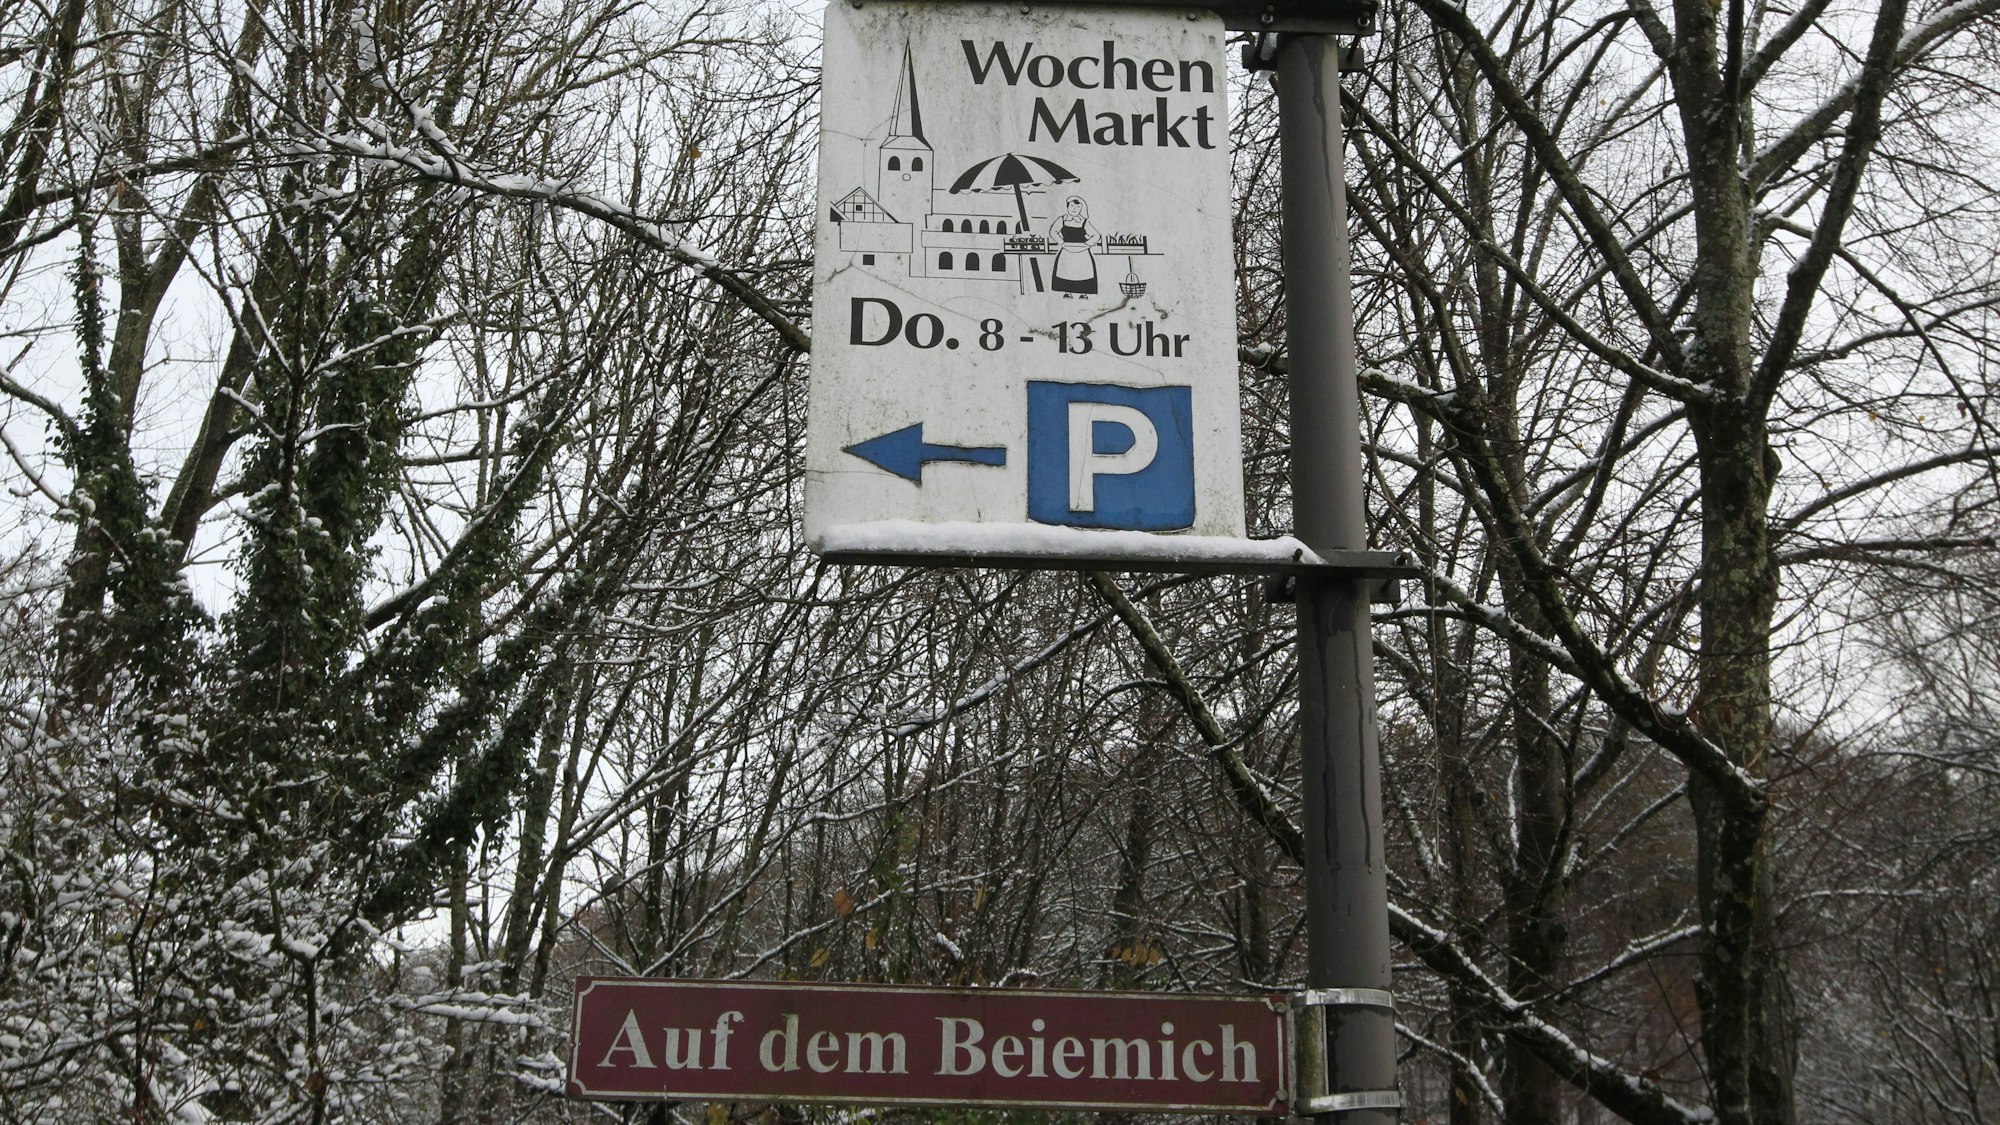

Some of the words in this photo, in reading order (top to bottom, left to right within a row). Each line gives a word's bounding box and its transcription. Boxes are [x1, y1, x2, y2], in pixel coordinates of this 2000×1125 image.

[960, 39, 1214, 94] Wochen
[1028, 97, 1217, 151] Markt
[848, 296, 960, 352] Do.
[978, 318, 1005, 351] 8
[1051, 321, 1094, 355] 13
[1109, 320, 1190, 358] Uhr
[1068, 402, 1159, 513] P
[596, 1009, 745, 1071] Auf
[759, 1013, 910, 1076] dem
[934, 1016, 1262, 1084] Beiemich
